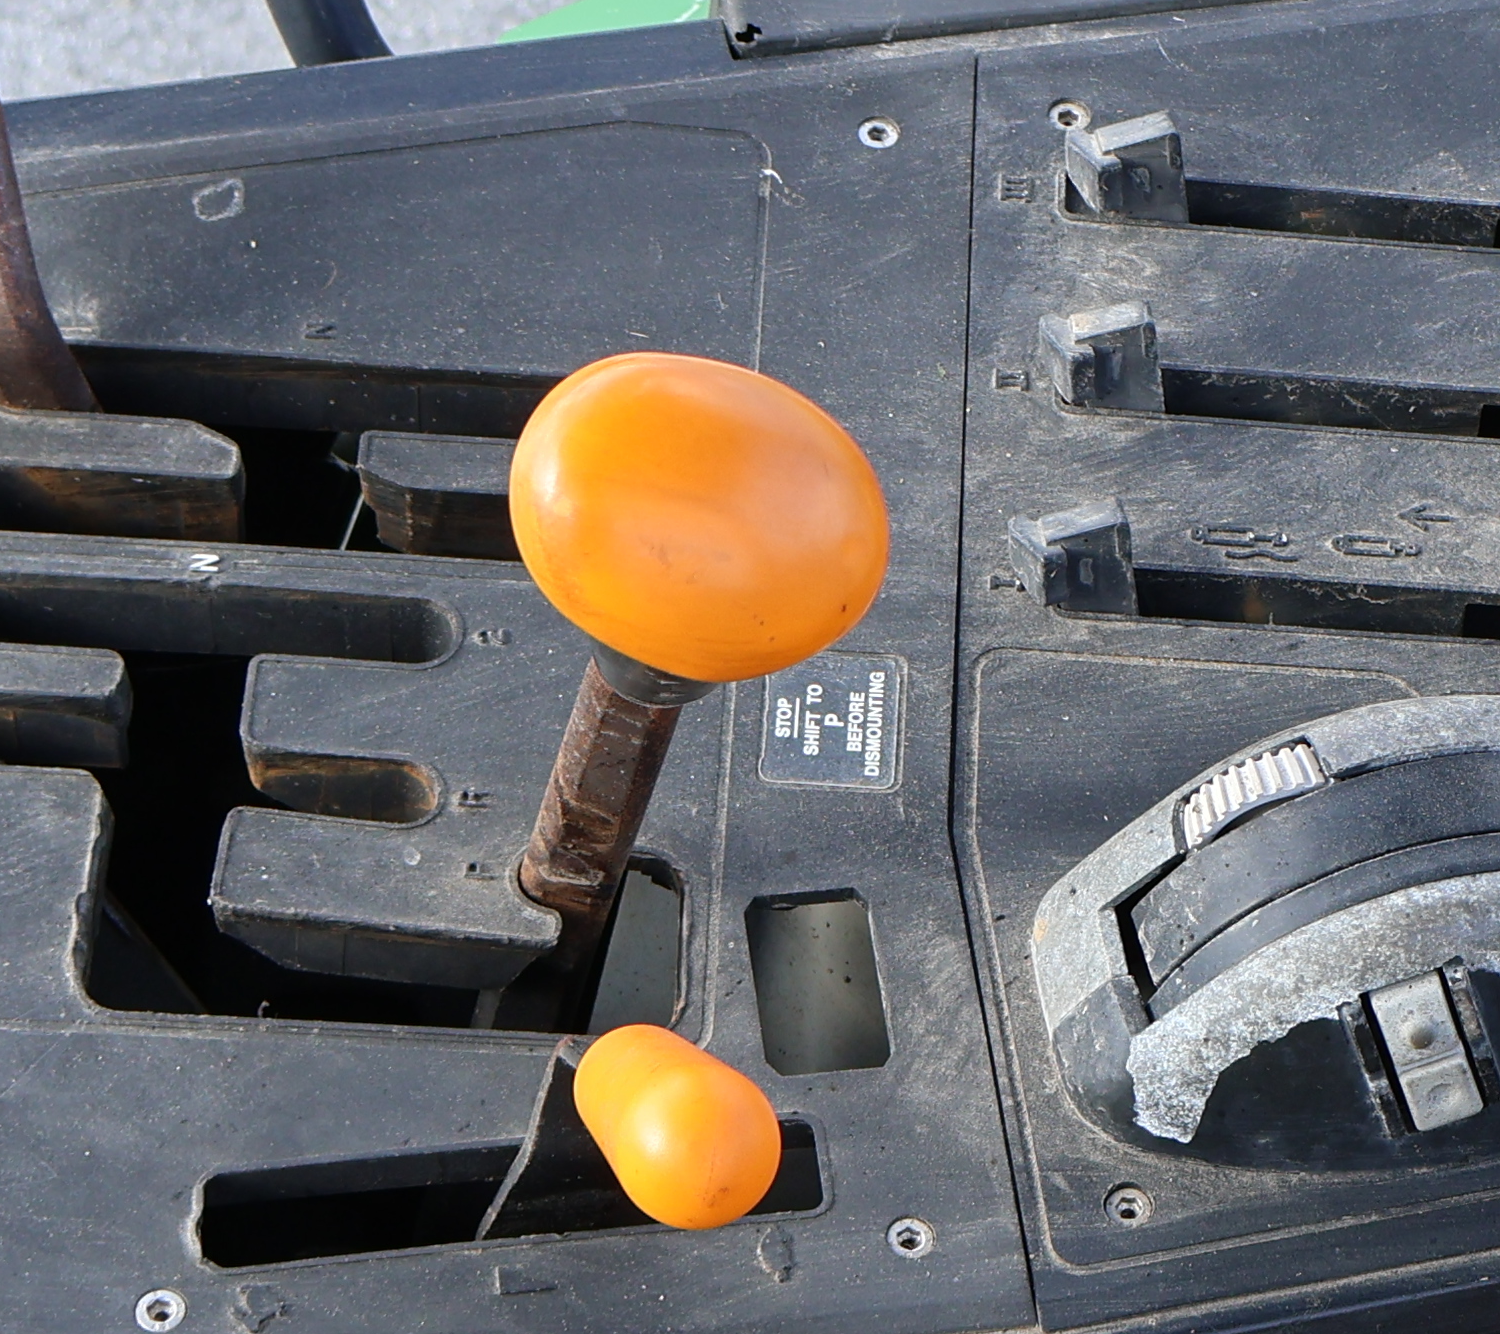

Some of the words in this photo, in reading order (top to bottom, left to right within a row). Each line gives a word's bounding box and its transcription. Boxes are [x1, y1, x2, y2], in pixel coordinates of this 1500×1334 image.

[190, 553, 220, 572] N
[806, 683, 823, 705] TO
[774, 697, 793, 738] STOP
[802, 710, 821, 756] SHIFT
[823, 713, 845, 728] P
[846, 691, 866, 752] BEFORE
[864, 671, 886, 777] DISMOUNTING
